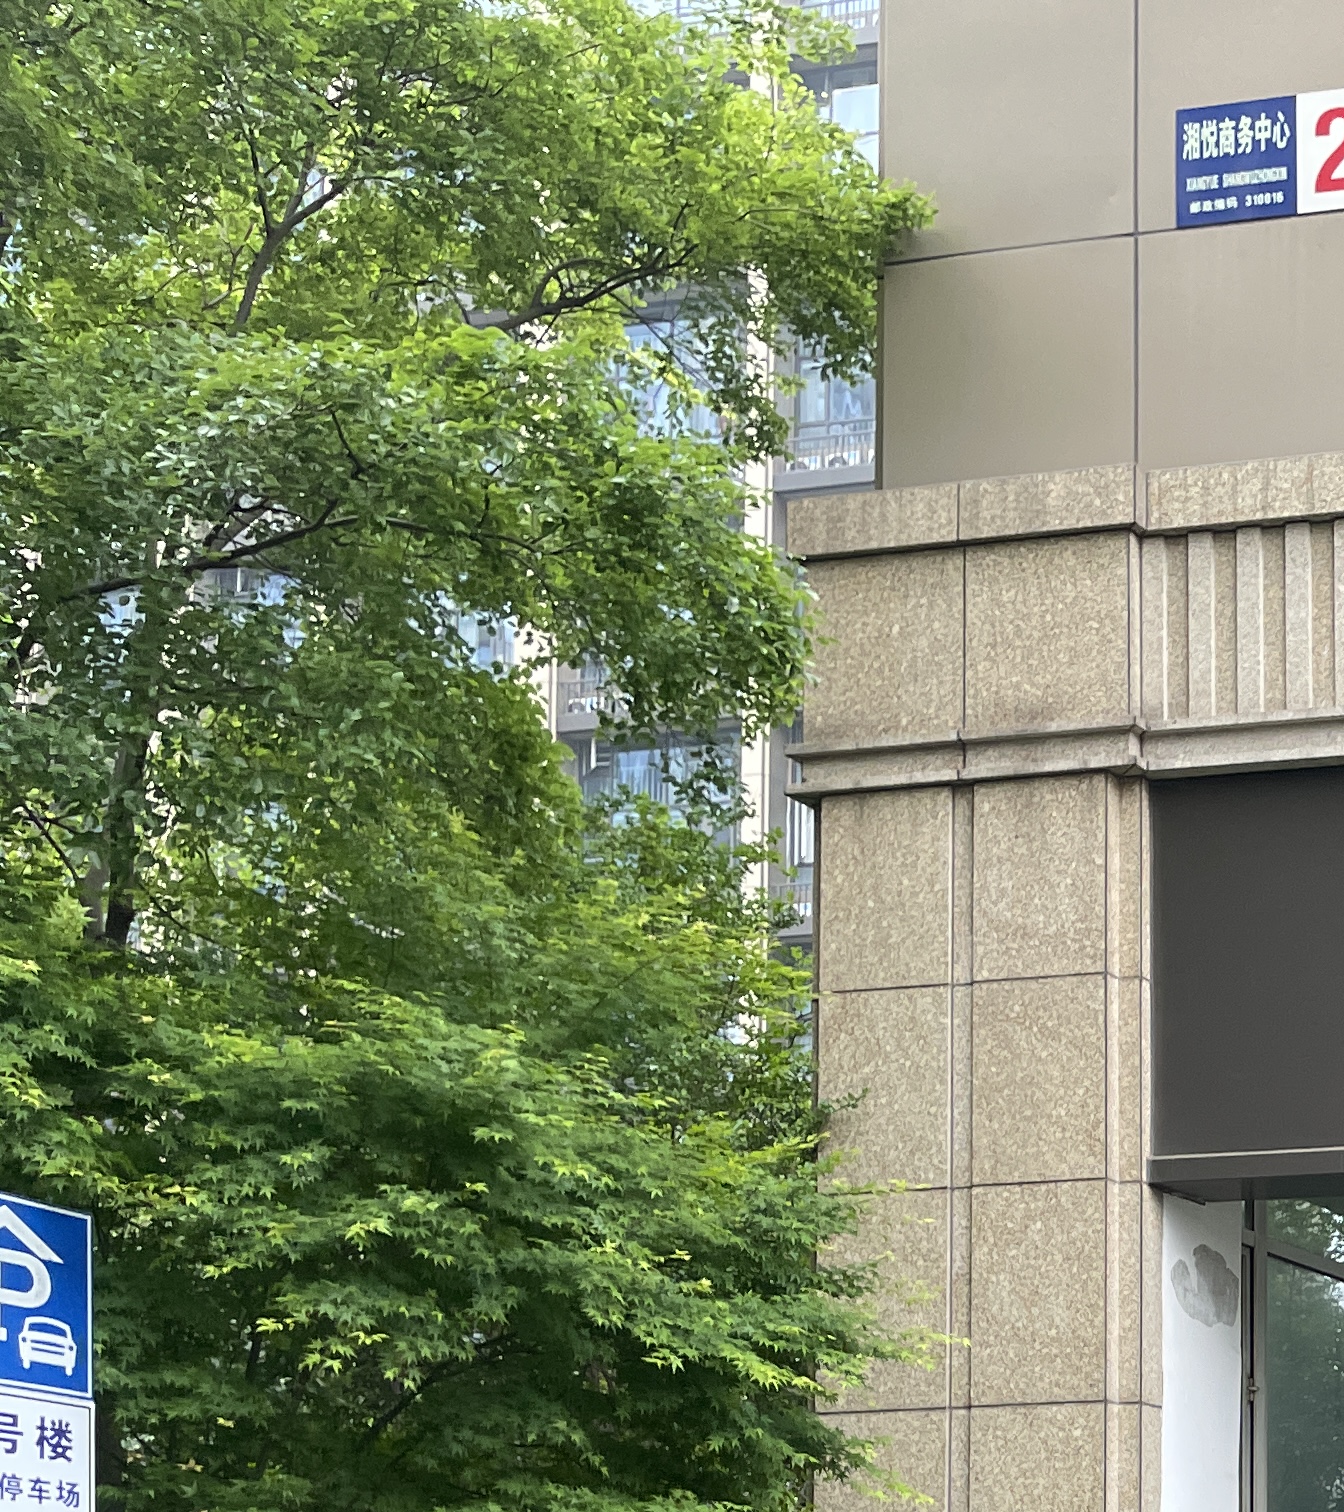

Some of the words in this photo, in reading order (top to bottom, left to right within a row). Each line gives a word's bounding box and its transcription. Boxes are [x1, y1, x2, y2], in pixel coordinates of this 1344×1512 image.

[1182, 110, 1291, 161] 湘悦商务中心
[0, 1471, 80, 1508] 停车场
